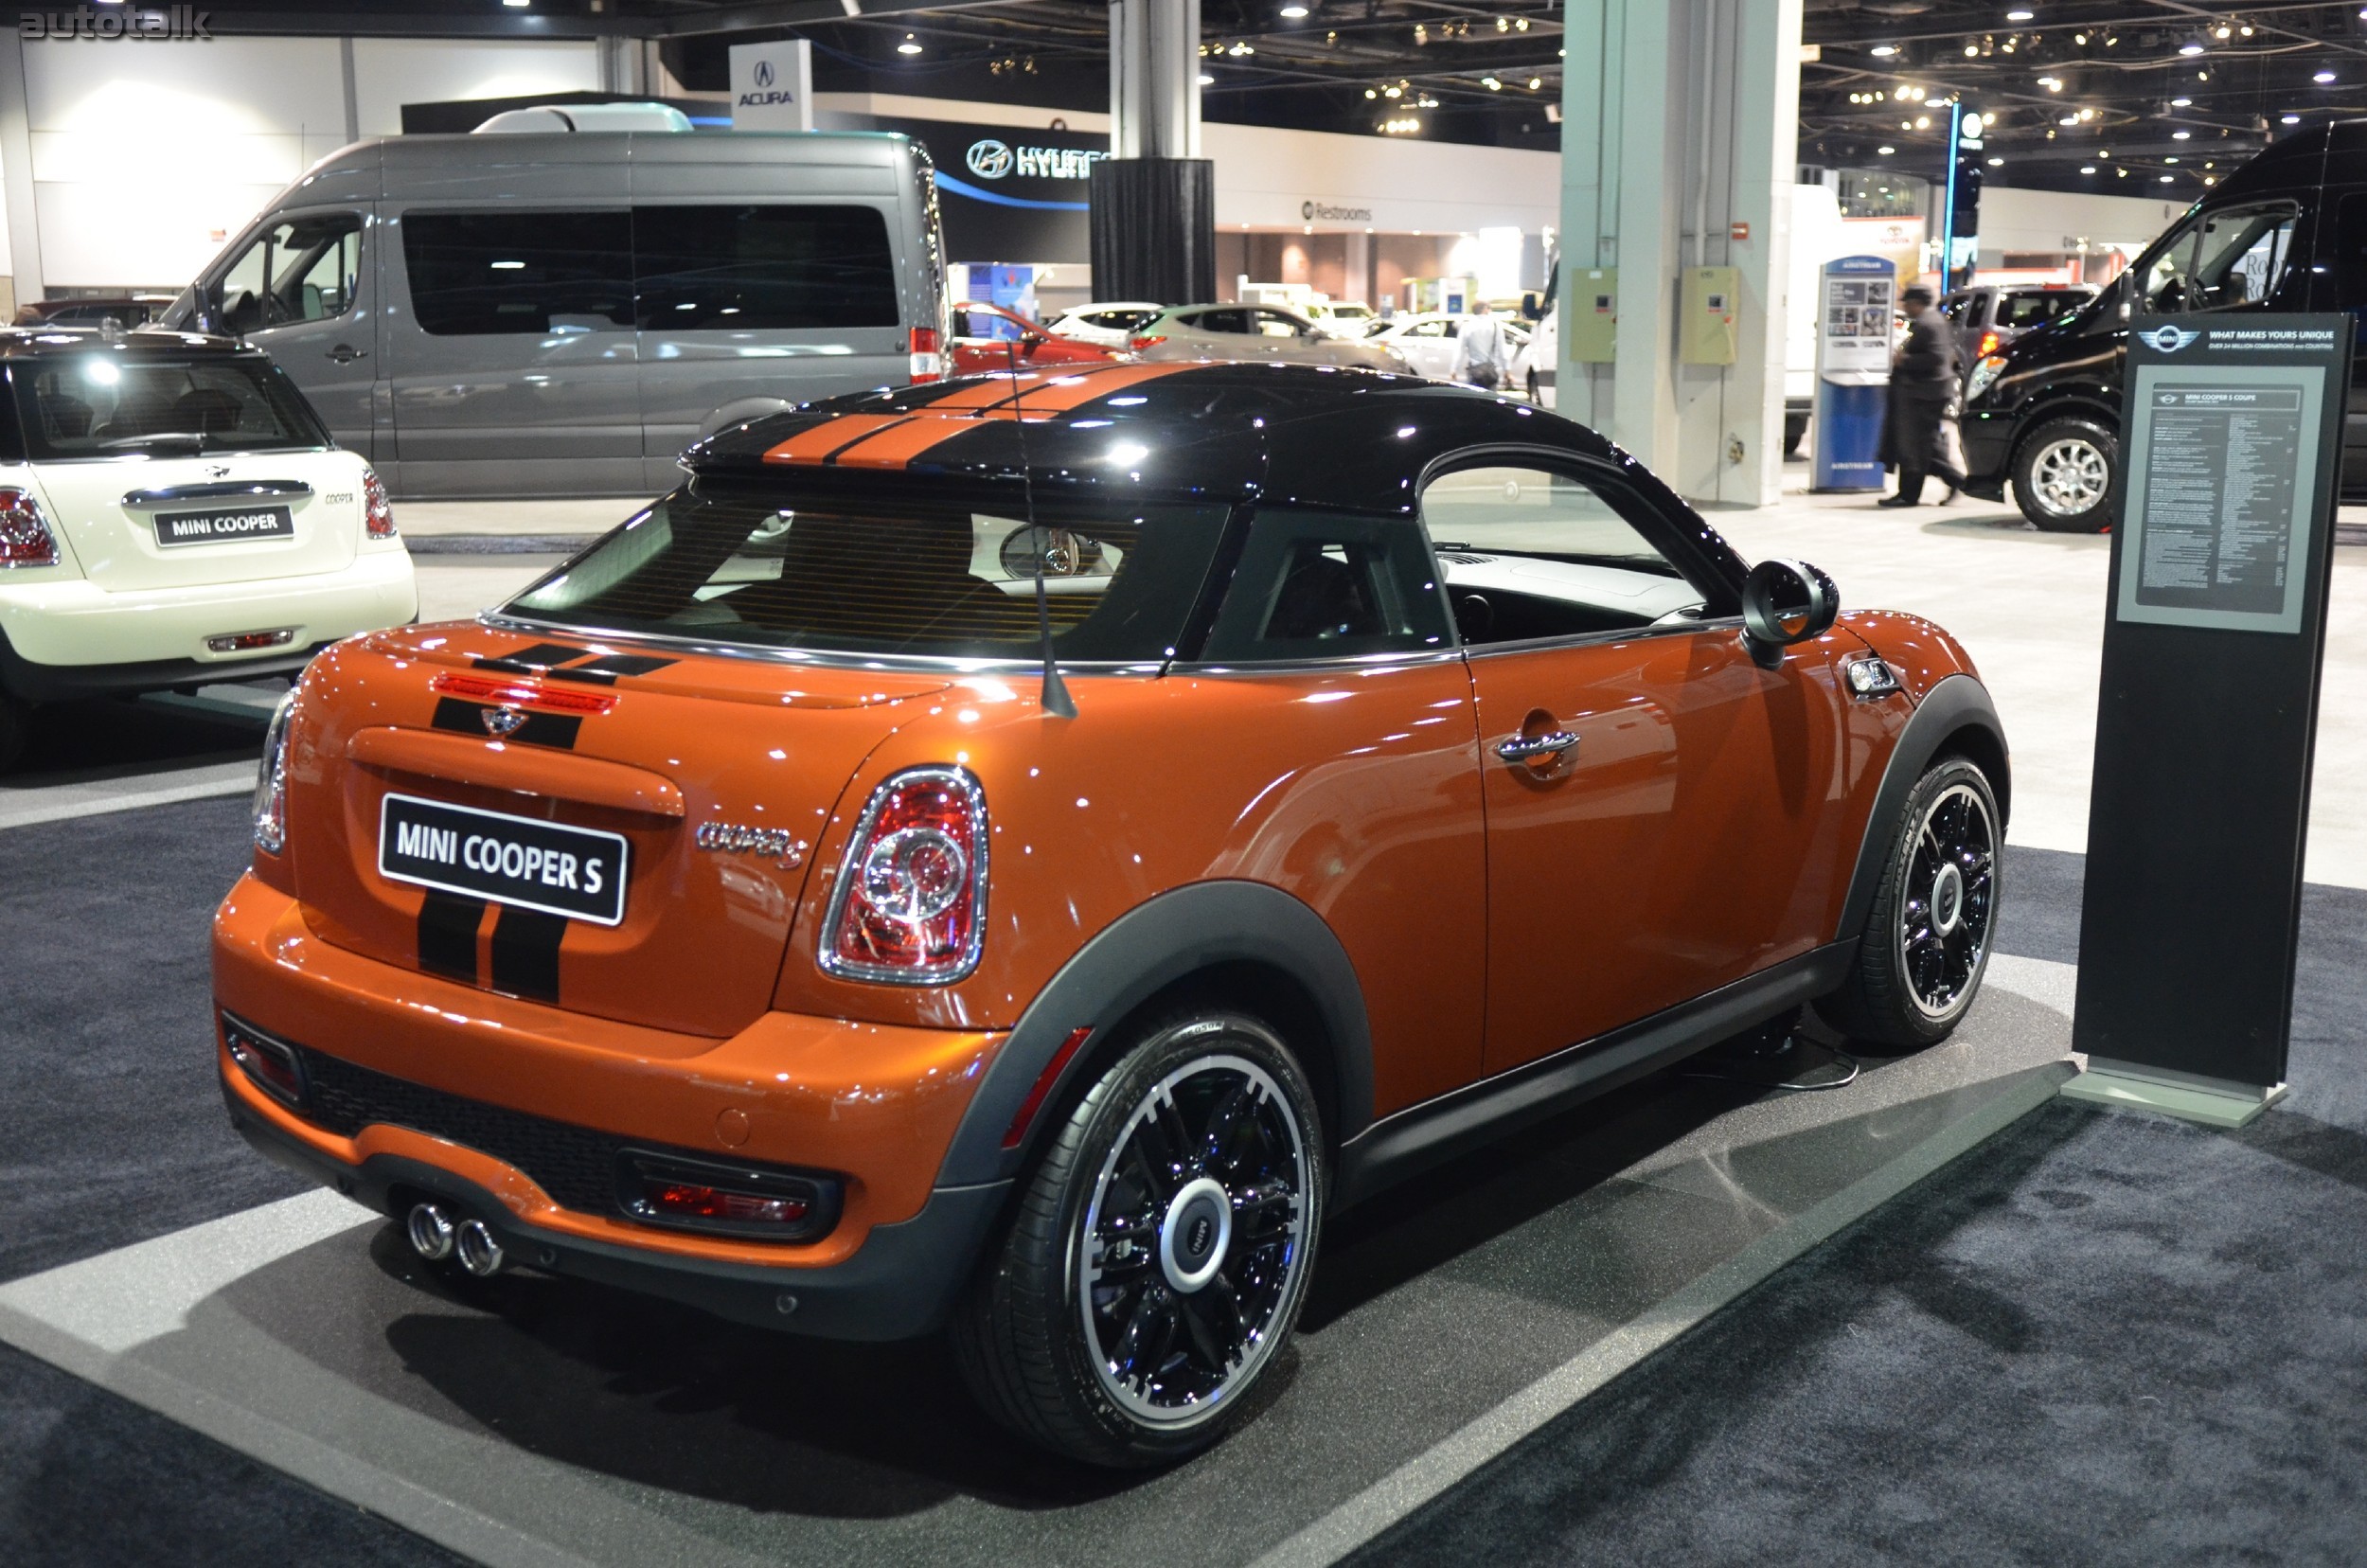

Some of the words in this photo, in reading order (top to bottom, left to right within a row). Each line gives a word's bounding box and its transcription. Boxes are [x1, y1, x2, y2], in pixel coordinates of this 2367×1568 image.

[739, 91, 793, 107] ACURA
[1315, 202, 1373, 222] Restrooms
[2160, 335, 2178, 344] MINI
[2209, 330, 2235, 340] WHAT
[2235, 330, 2267, 340] MAKES
[2268, 330, 2298, 340] YOURS
[2298, 330, 2335, 340] UNIQUE
[171, 520, 211, 536] MINI
[214, 513, 278, 533] COOPER
[697, 821, 790, 857] COOPER
[398, 821, 457, 865] MINI
[464, 835, 578, 890] COOPER
[583, 858, 603, 894] S
[1192, 1220, 1207, 1252] MINI
